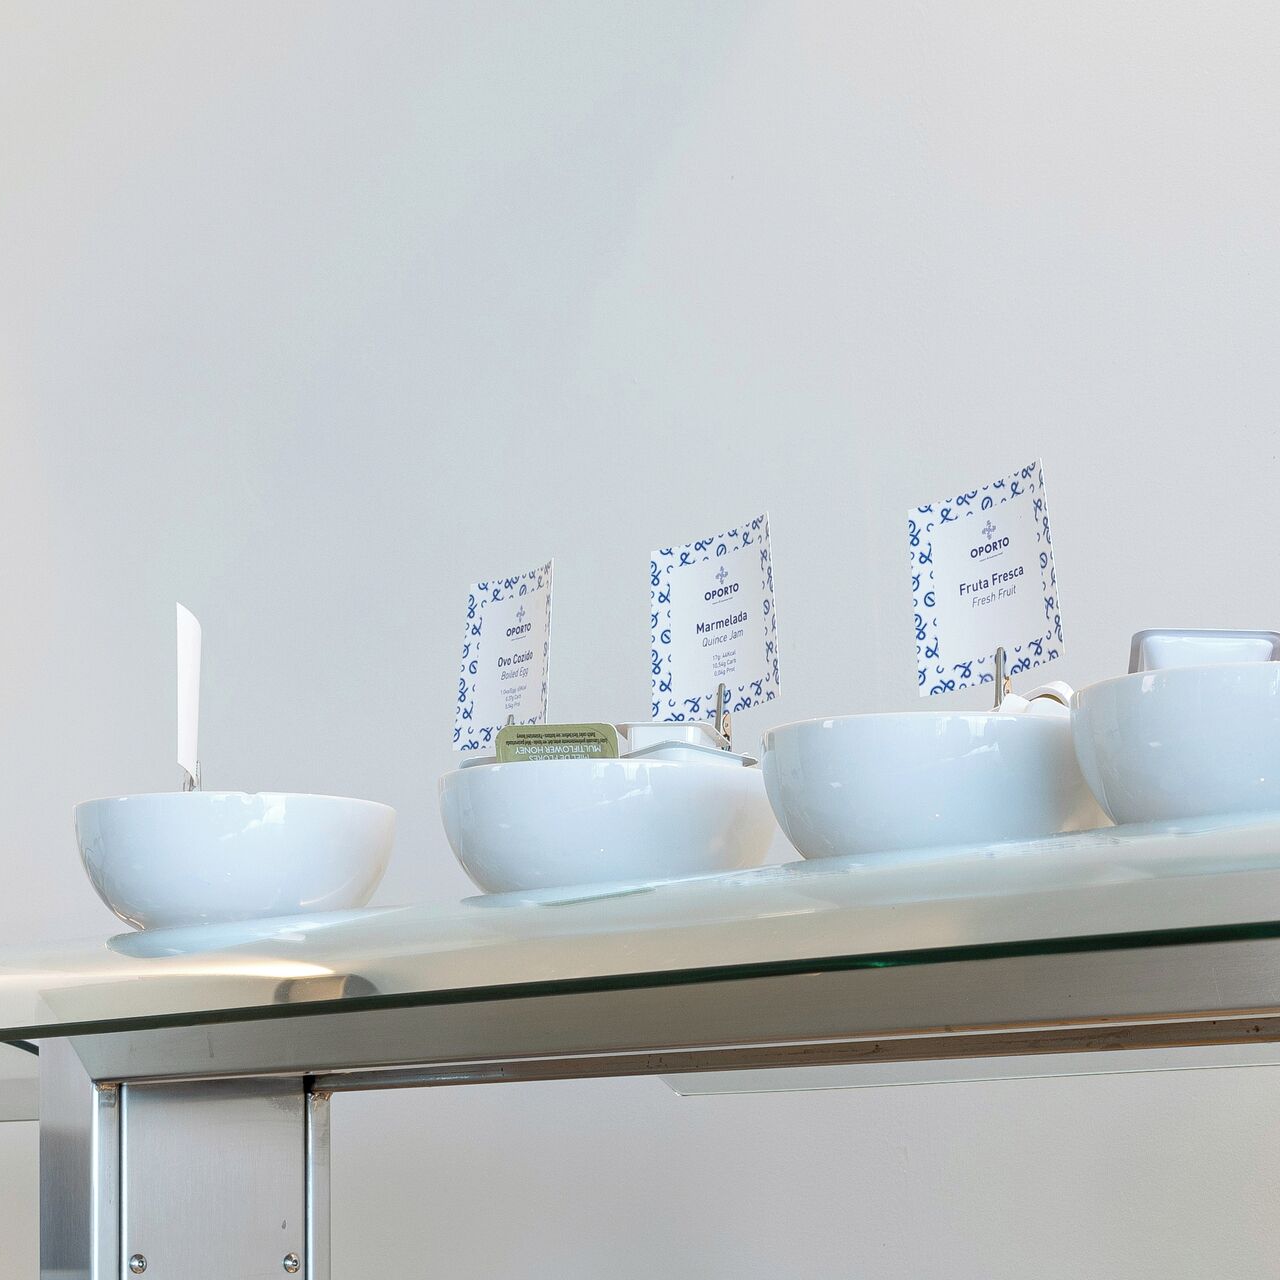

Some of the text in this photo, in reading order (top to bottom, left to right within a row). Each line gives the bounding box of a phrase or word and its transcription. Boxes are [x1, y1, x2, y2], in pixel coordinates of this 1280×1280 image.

[970, 537, 1010, 558] OPORTO
[959, 566, 1024, 596] Fruta Fresca
[704, 583, 739, 601] OPORTO
[972, 585, 1017, 608] Fresh Fruit
[506, 622, 532, 637] OPORTO
[696, 611, 748, 634] Marmelada
[702, 629, 744, 647] Quince Jam
[497, 650, 534, 668] Ovo Cozido
[516, 744, 602, 754] MULTIFLOWER HONEY
